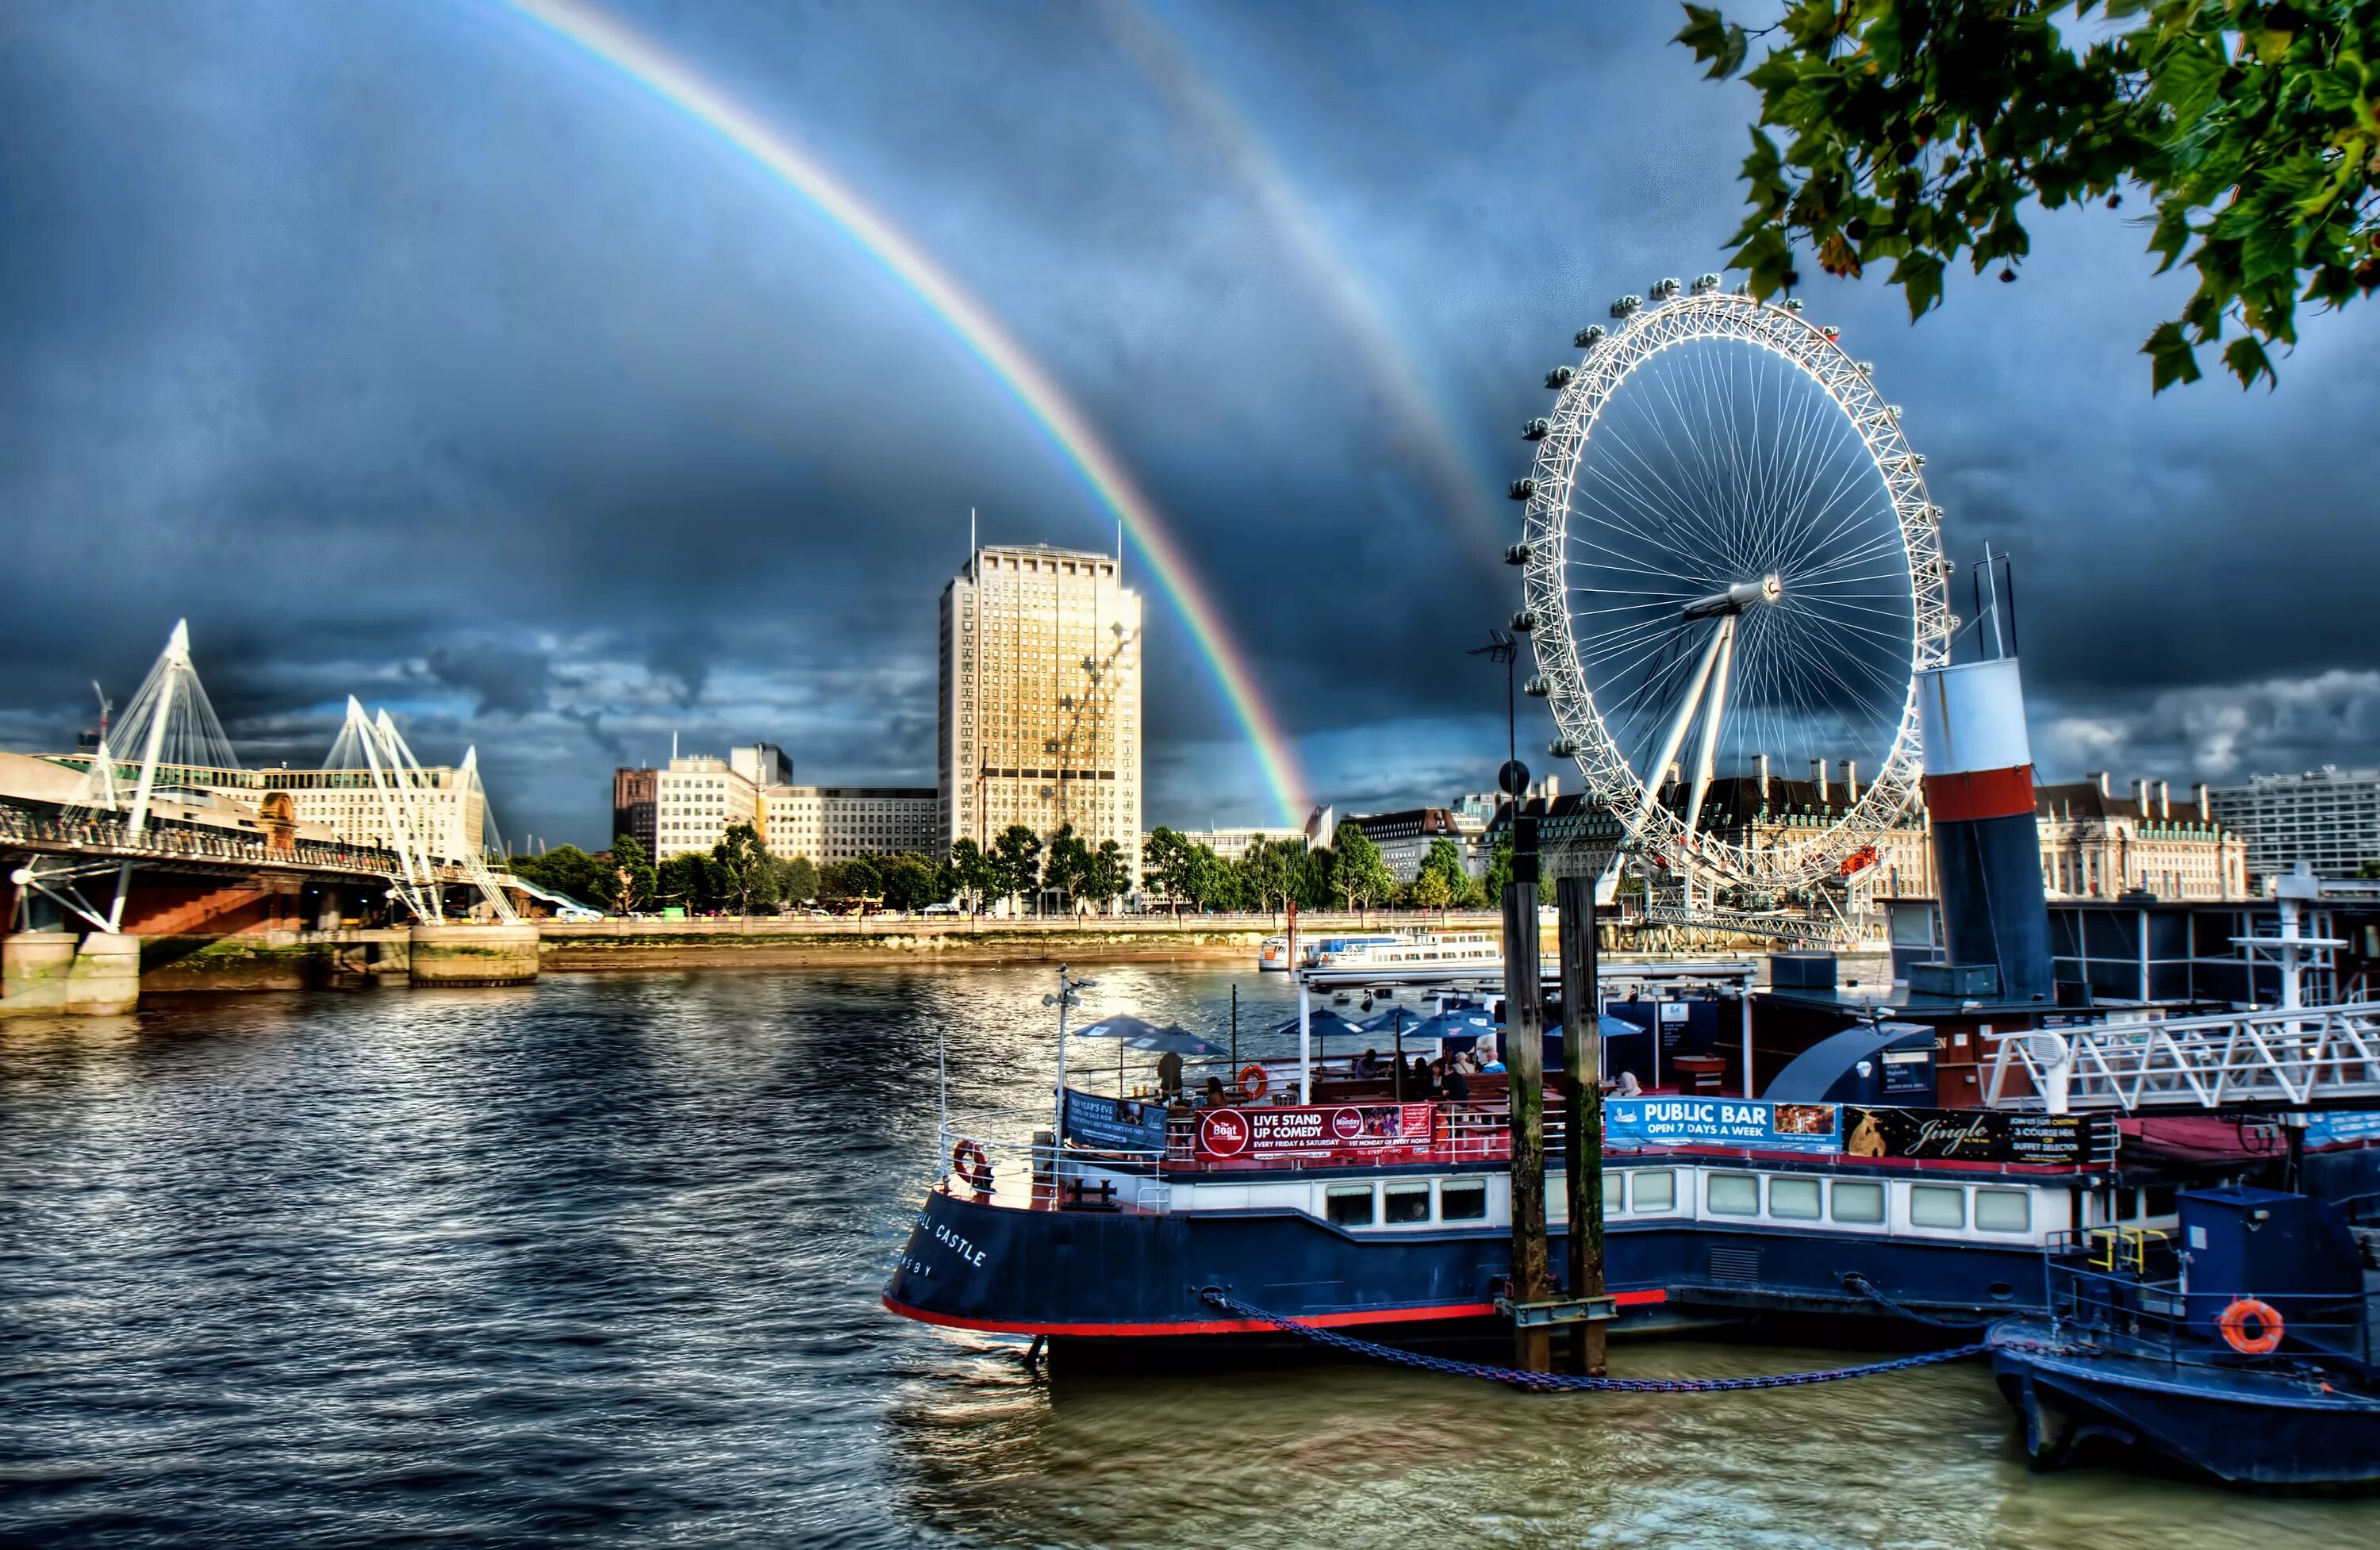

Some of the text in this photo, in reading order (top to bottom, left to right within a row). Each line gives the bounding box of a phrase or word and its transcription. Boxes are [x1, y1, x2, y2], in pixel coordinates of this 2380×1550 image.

[1081, 1102, 1100, 1113] YEAR'S
[1100, 1105, 1114, 1115] EVE
[1645, 1103, 1768, 1125] PUBLIC BAR
[1253, 1114, 1322, 1126] LIVE STAND
[1214, 1125, 1237, 1135] Boat
[1253, 1126, 1323, 1138] UP COMEDY
[1648, 1123, 1764, 1137] OPEN 7 DAYS A WEEK
[1904, 1115, 1988, 1156] Jingle
[2014, 1127, 2021, 1136] 3
[2022, 1128, 2059, 1137] COURSE
[936, 1224, 987, 1268] CASTLE
